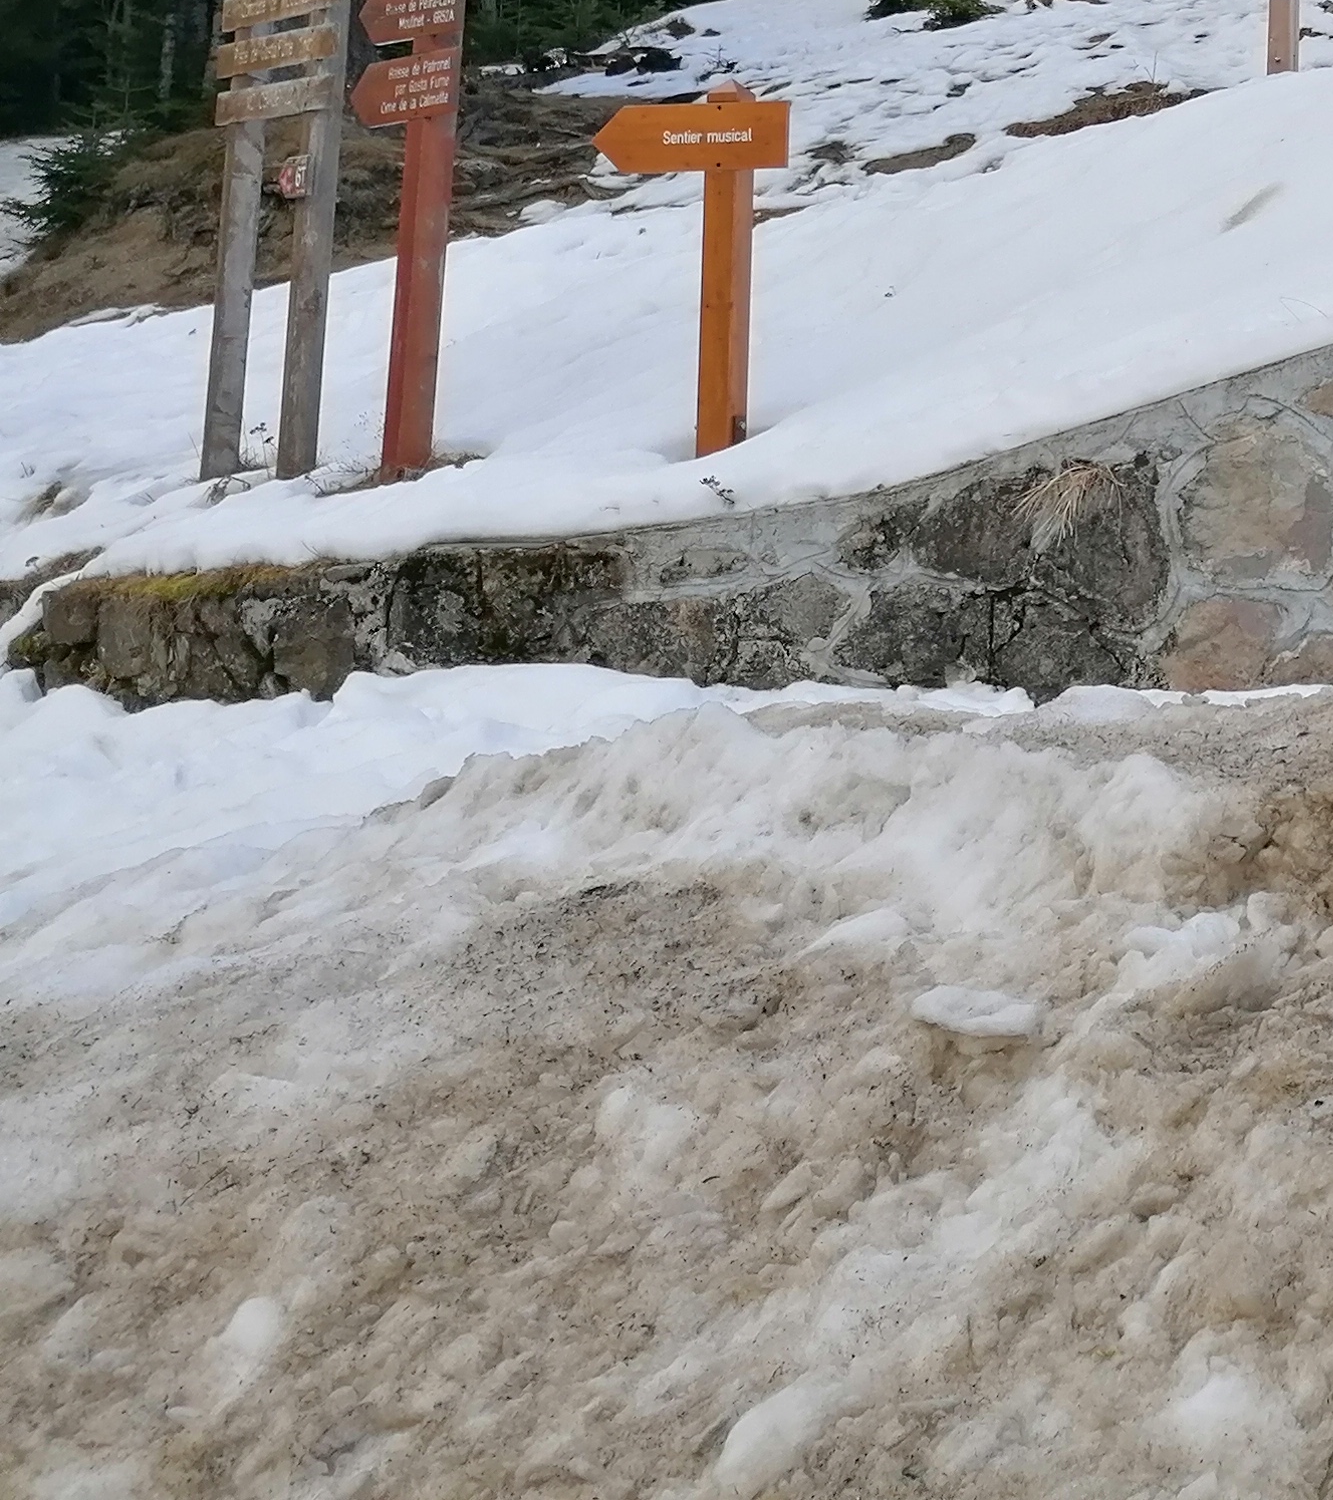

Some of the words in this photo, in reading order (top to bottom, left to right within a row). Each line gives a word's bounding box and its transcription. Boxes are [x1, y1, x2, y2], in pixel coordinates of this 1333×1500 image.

[407, 0, 417, 12] de
[398, 14, 424, 29] Moulinet
[411, 62, 421, 75] de
[398, 98, 408, 111] de
[662, 129, 703, 145] Sentier
[706, 127, 752, 144] musical
